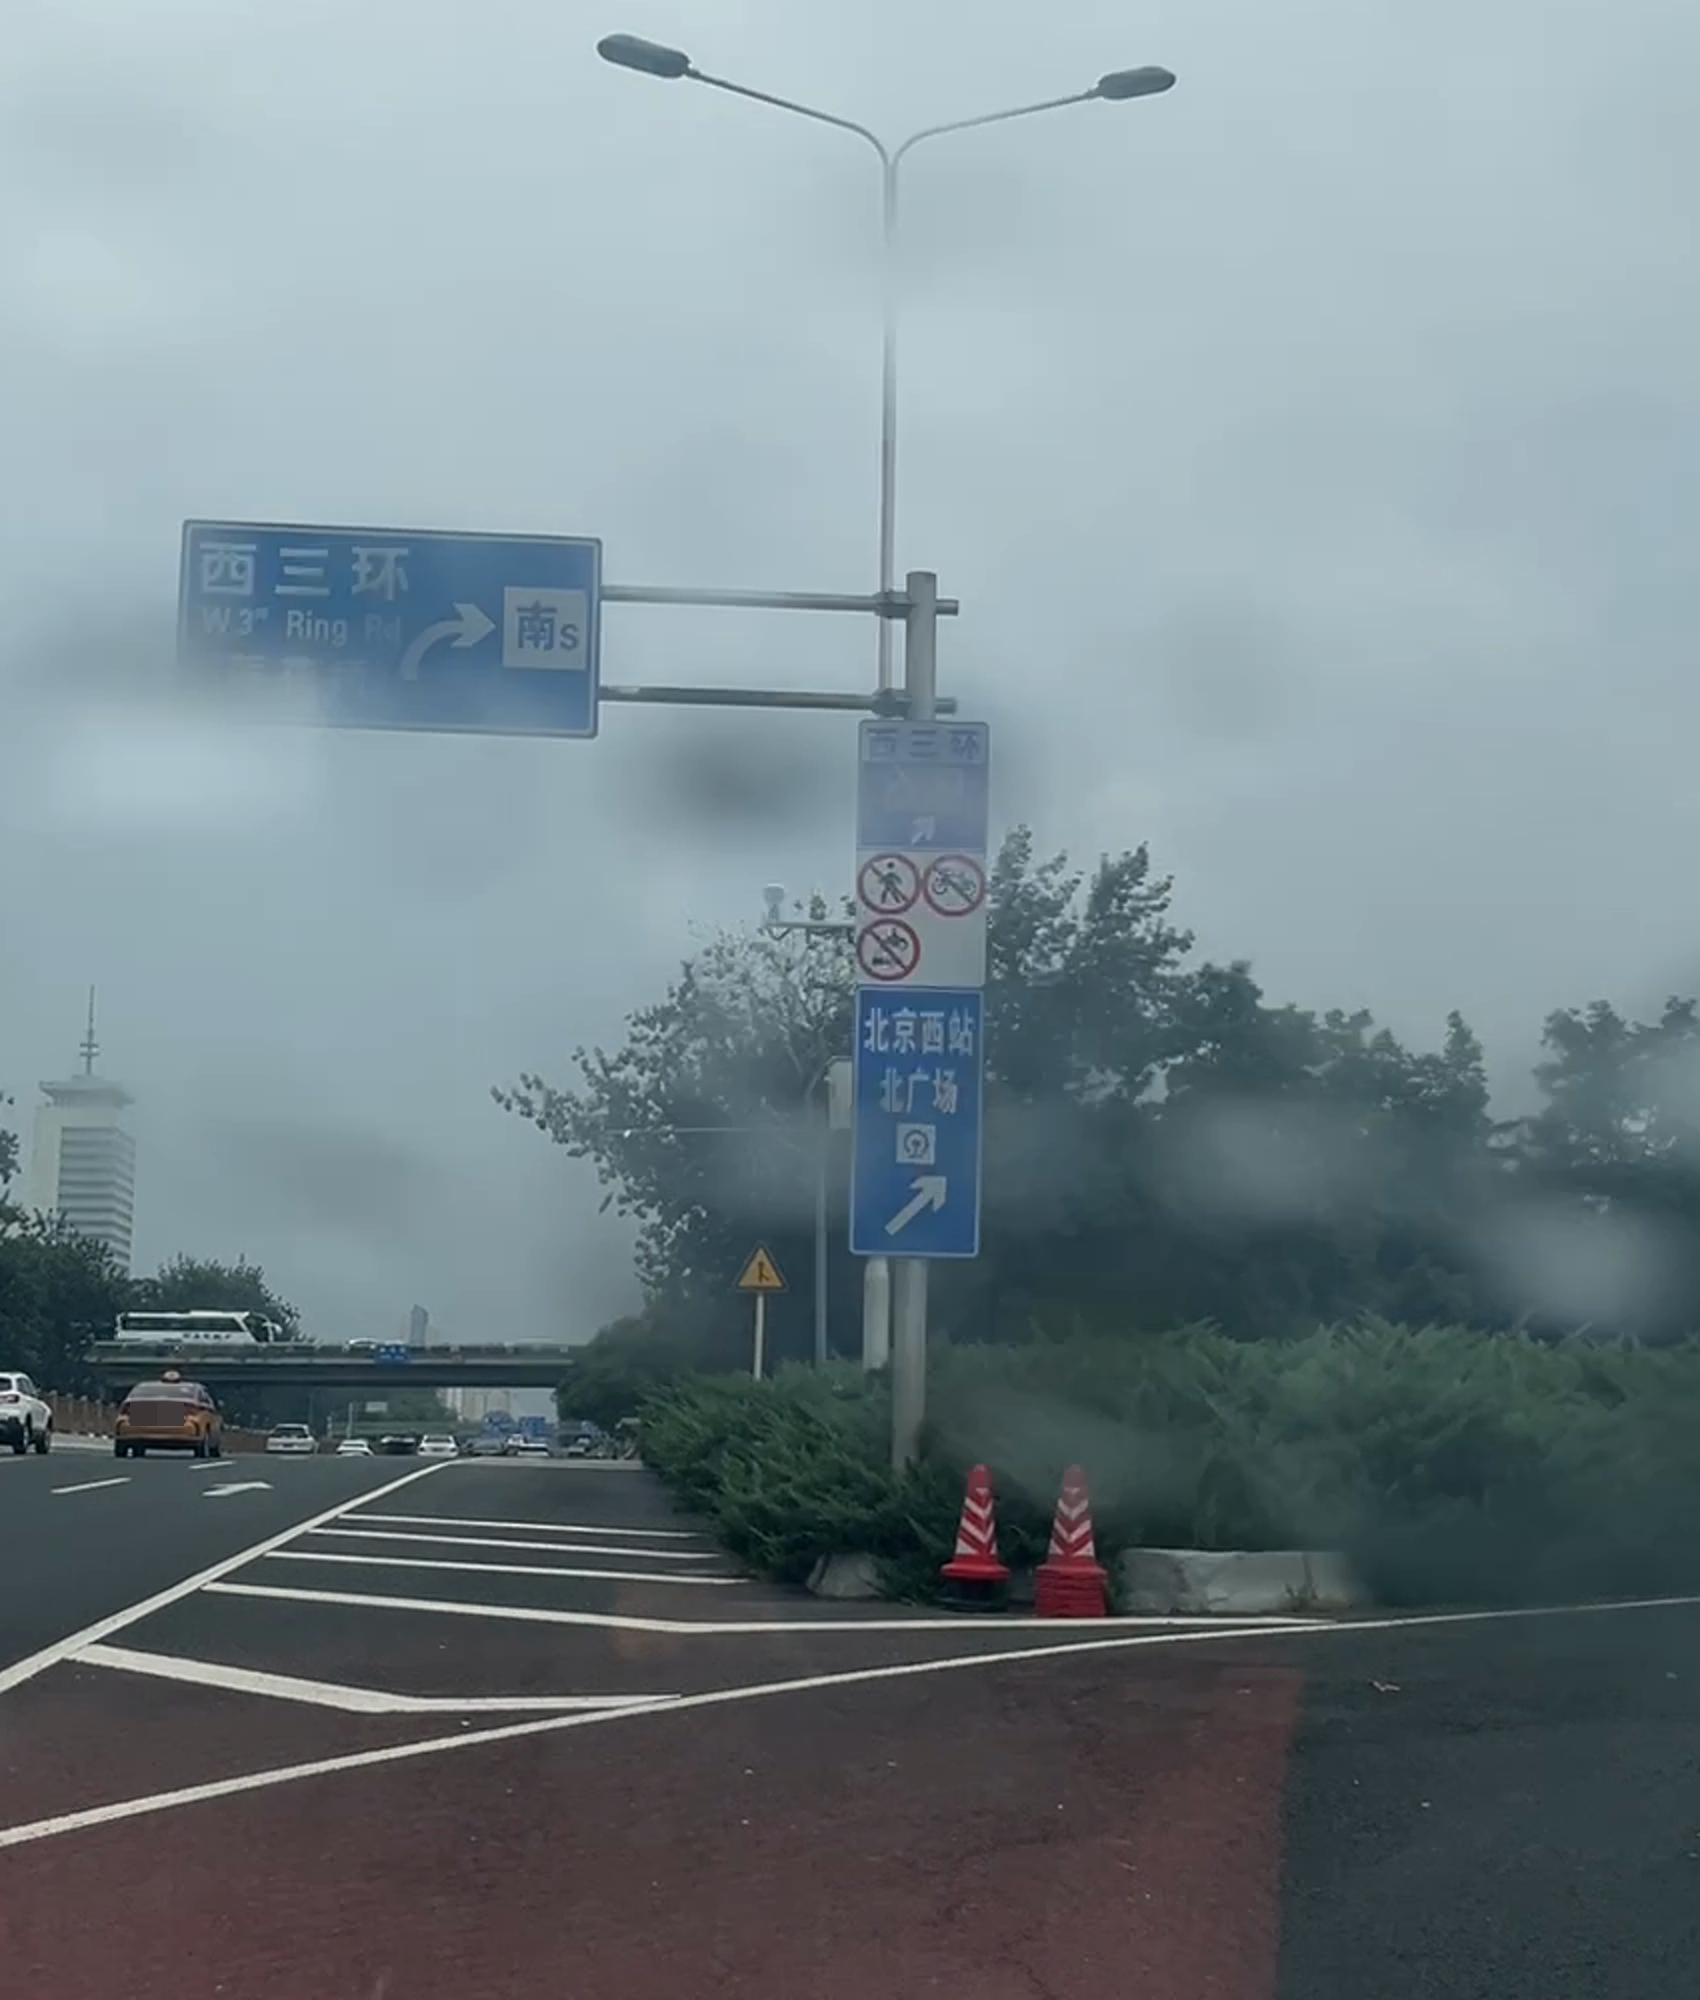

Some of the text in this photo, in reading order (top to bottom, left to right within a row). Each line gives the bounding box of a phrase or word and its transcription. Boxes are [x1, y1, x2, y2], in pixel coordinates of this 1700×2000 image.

[201, 542, 409, 600] 西三环
[287, 610, 348, 644] Ring
[867, 728, 982, 760] 西三环
[864, 1007, 974, 1055] 北京西站
[880, 1067, 958, 1114] 北广场
